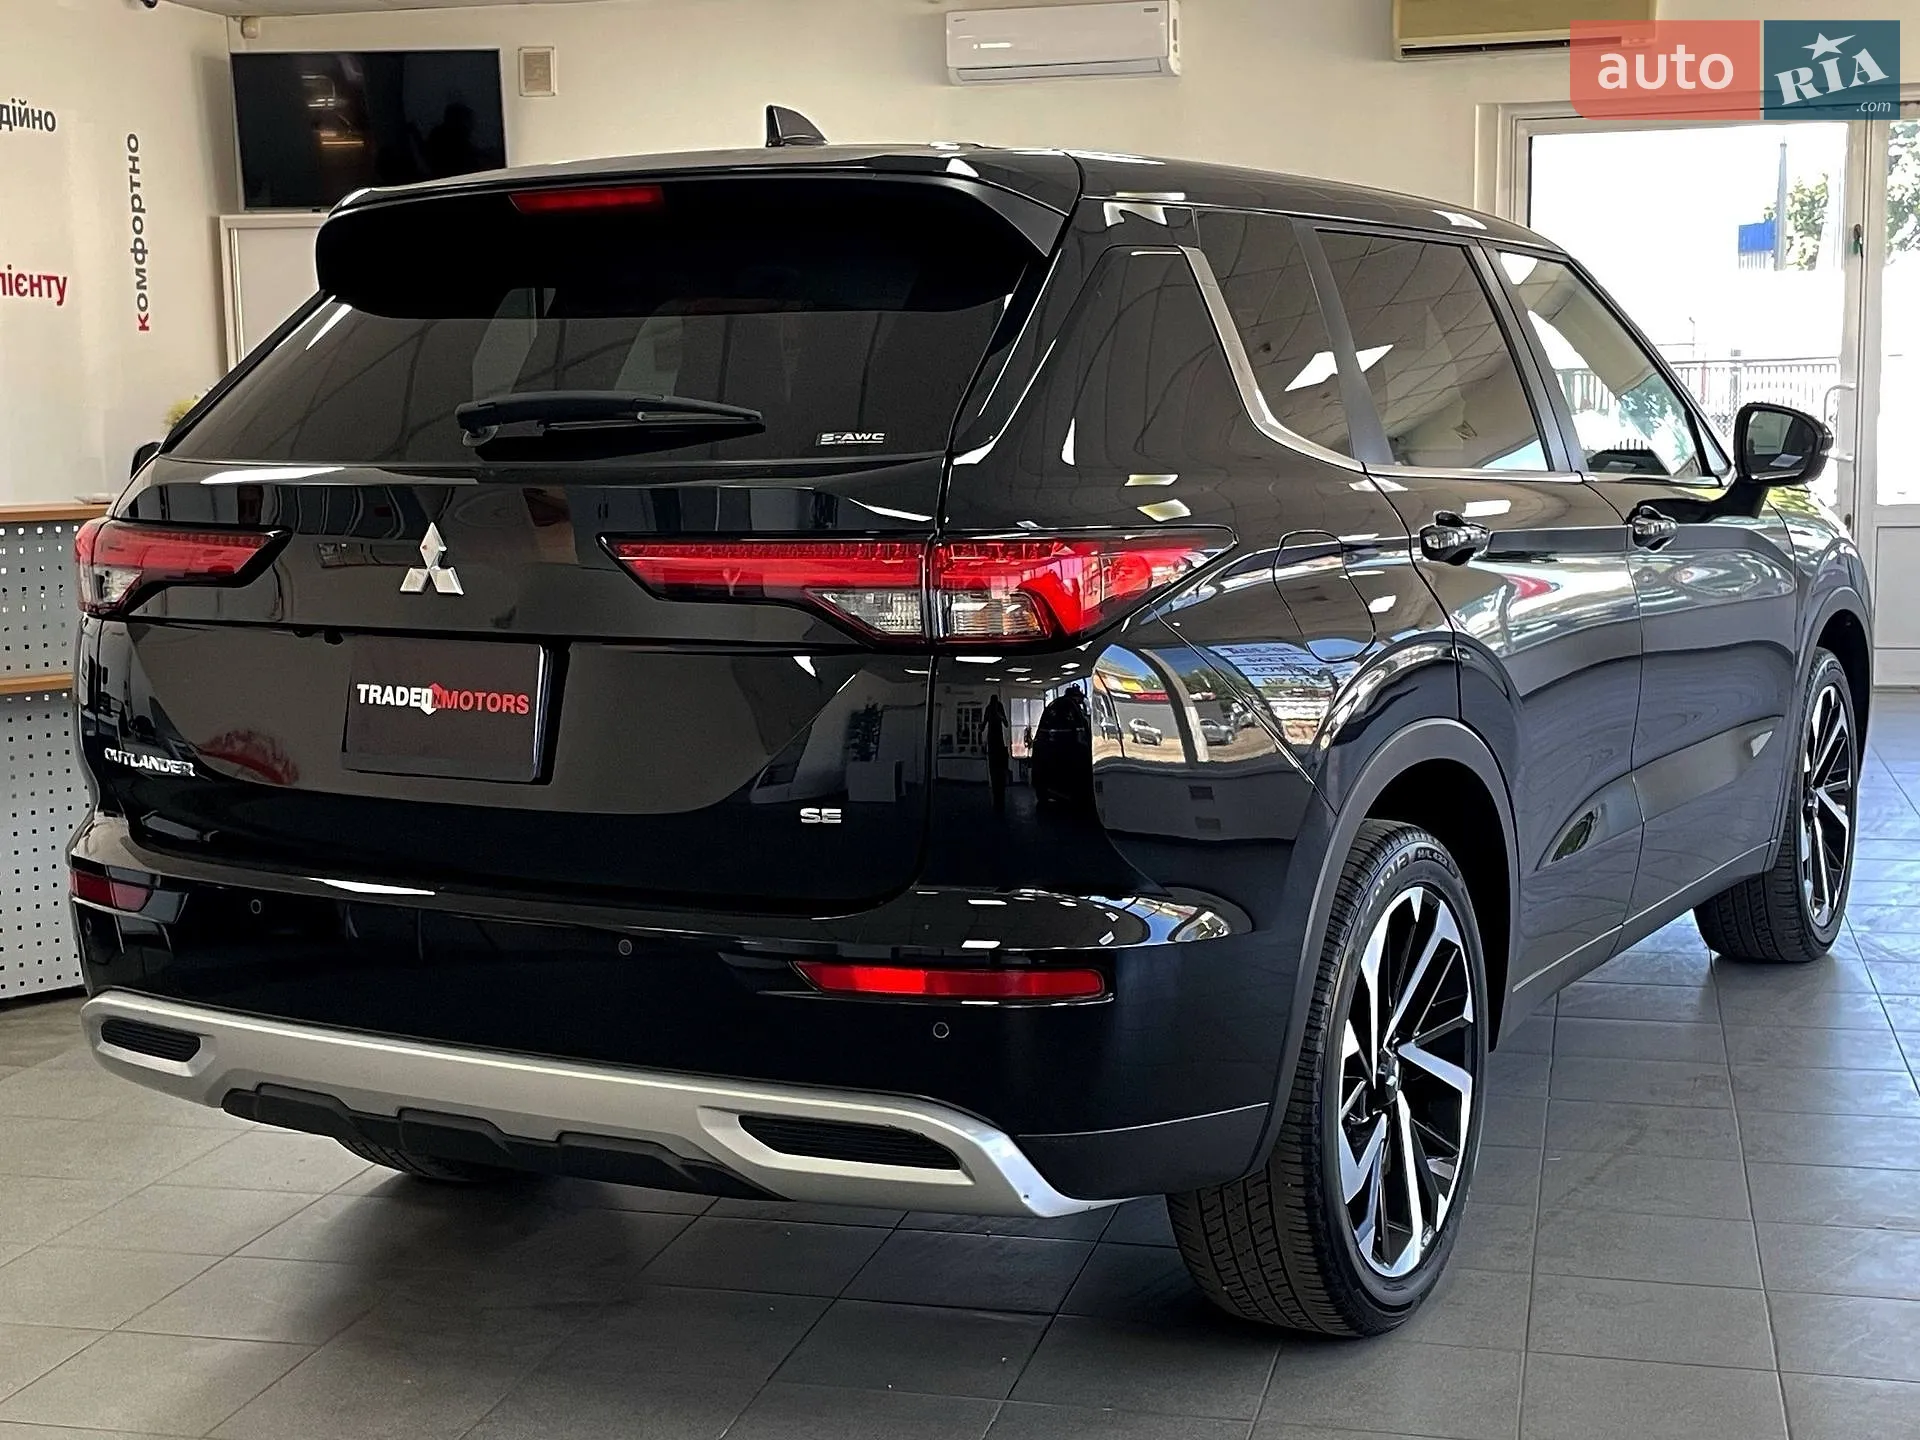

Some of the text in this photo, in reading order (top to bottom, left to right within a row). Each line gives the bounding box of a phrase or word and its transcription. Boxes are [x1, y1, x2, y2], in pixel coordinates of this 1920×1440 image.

[0, 98, 56, 132] дійно
[127, 133, 149, 331] комфортно
[820, 432, 885, 444] S-AWC
[442, 690, 530, 715] MOTORS
[104, 747, 196, 777] OUTLANDER
[800, 808, 842, 824] SE
